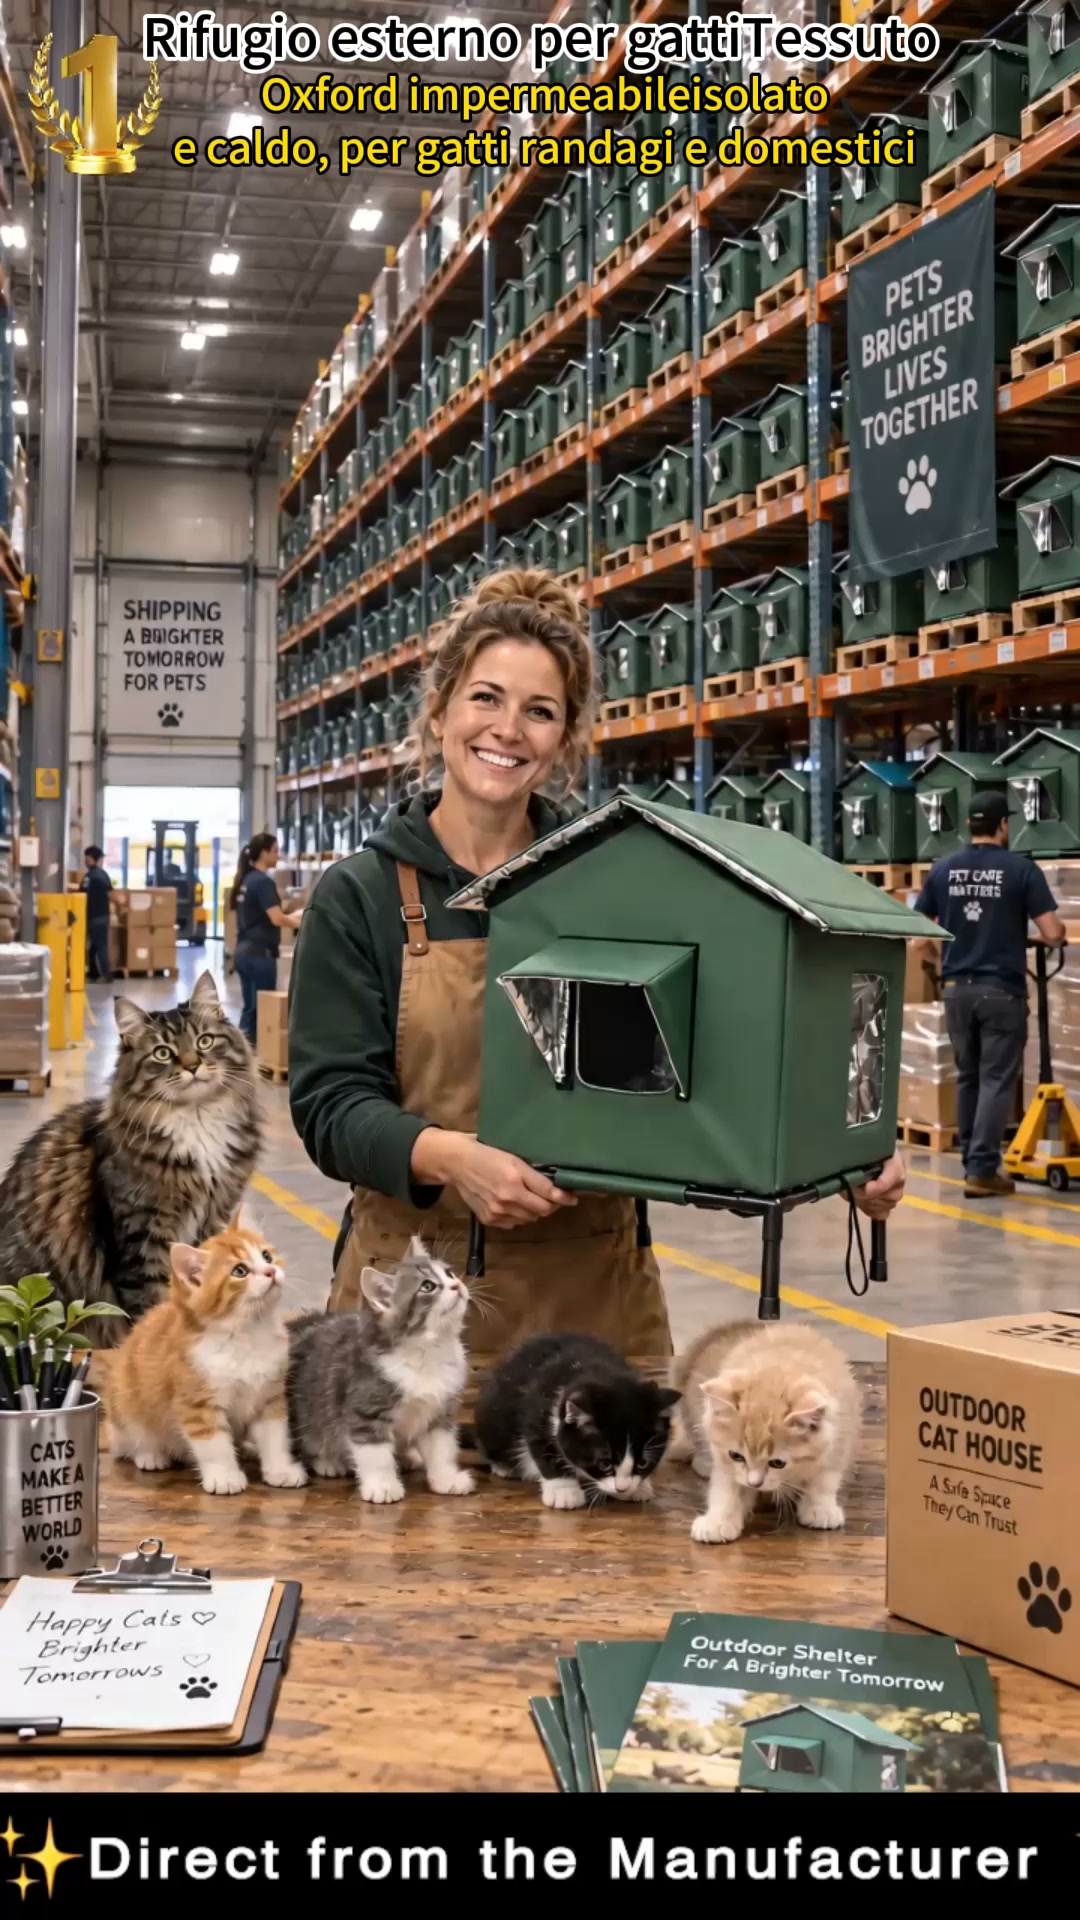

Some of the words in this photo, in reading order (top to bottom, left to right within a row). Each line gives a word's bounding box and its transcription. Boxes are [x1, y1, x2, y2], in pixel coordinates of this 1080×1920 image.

[886, 259, 943, 317] PETS
[862, 290, 975, 368] BRIGHTER
[885, 346, 948, 400] LIVES
[861, 378, 979, 449] TOGETHER
[124, 600, 222, 621] SHIPPING
[124, 628, 135, 645] A
[124, 651, 225, 667] TOMORROW
[124, 674, 159, 691] FOR
[164, 674, 207, 691] PETS
[920, 1387, 1026, 1433] OUTDOOR
[31, 1440, 75, 1463] CATS
[919, 1421, 959, 1453] CAT
[966, 1431, 1043, 1473] HOUSE
[22, 1466, 70, 1491] MAKE
[74, 1464, 85, 1484] A
[930, 1475, 939, 1491] A
[22, 1491, 83, 1518] BETTER
[923, 1495, 954, 1522] They
[956, 1504, 979, 1526] Can
[984, 1511, 1018, 1536] Trust
[22, 1518, 82, 1544] WORLD
[26, 1611, 112, 1636] Happy
[38, 1637, 148, 1662] Brighter
[691, 1636, 787, 1657] Outdoor
[793, 1644, 878, 1666] Shelter
[19, 1664, 163, 1685] Tomorrows
[683, 1654, 718, 1670] For
[724, 1658, 739, 1672] A
[746, 1661, 832, 1680] Brighter
[837, 1668, 945, 1693] Tomorrow
